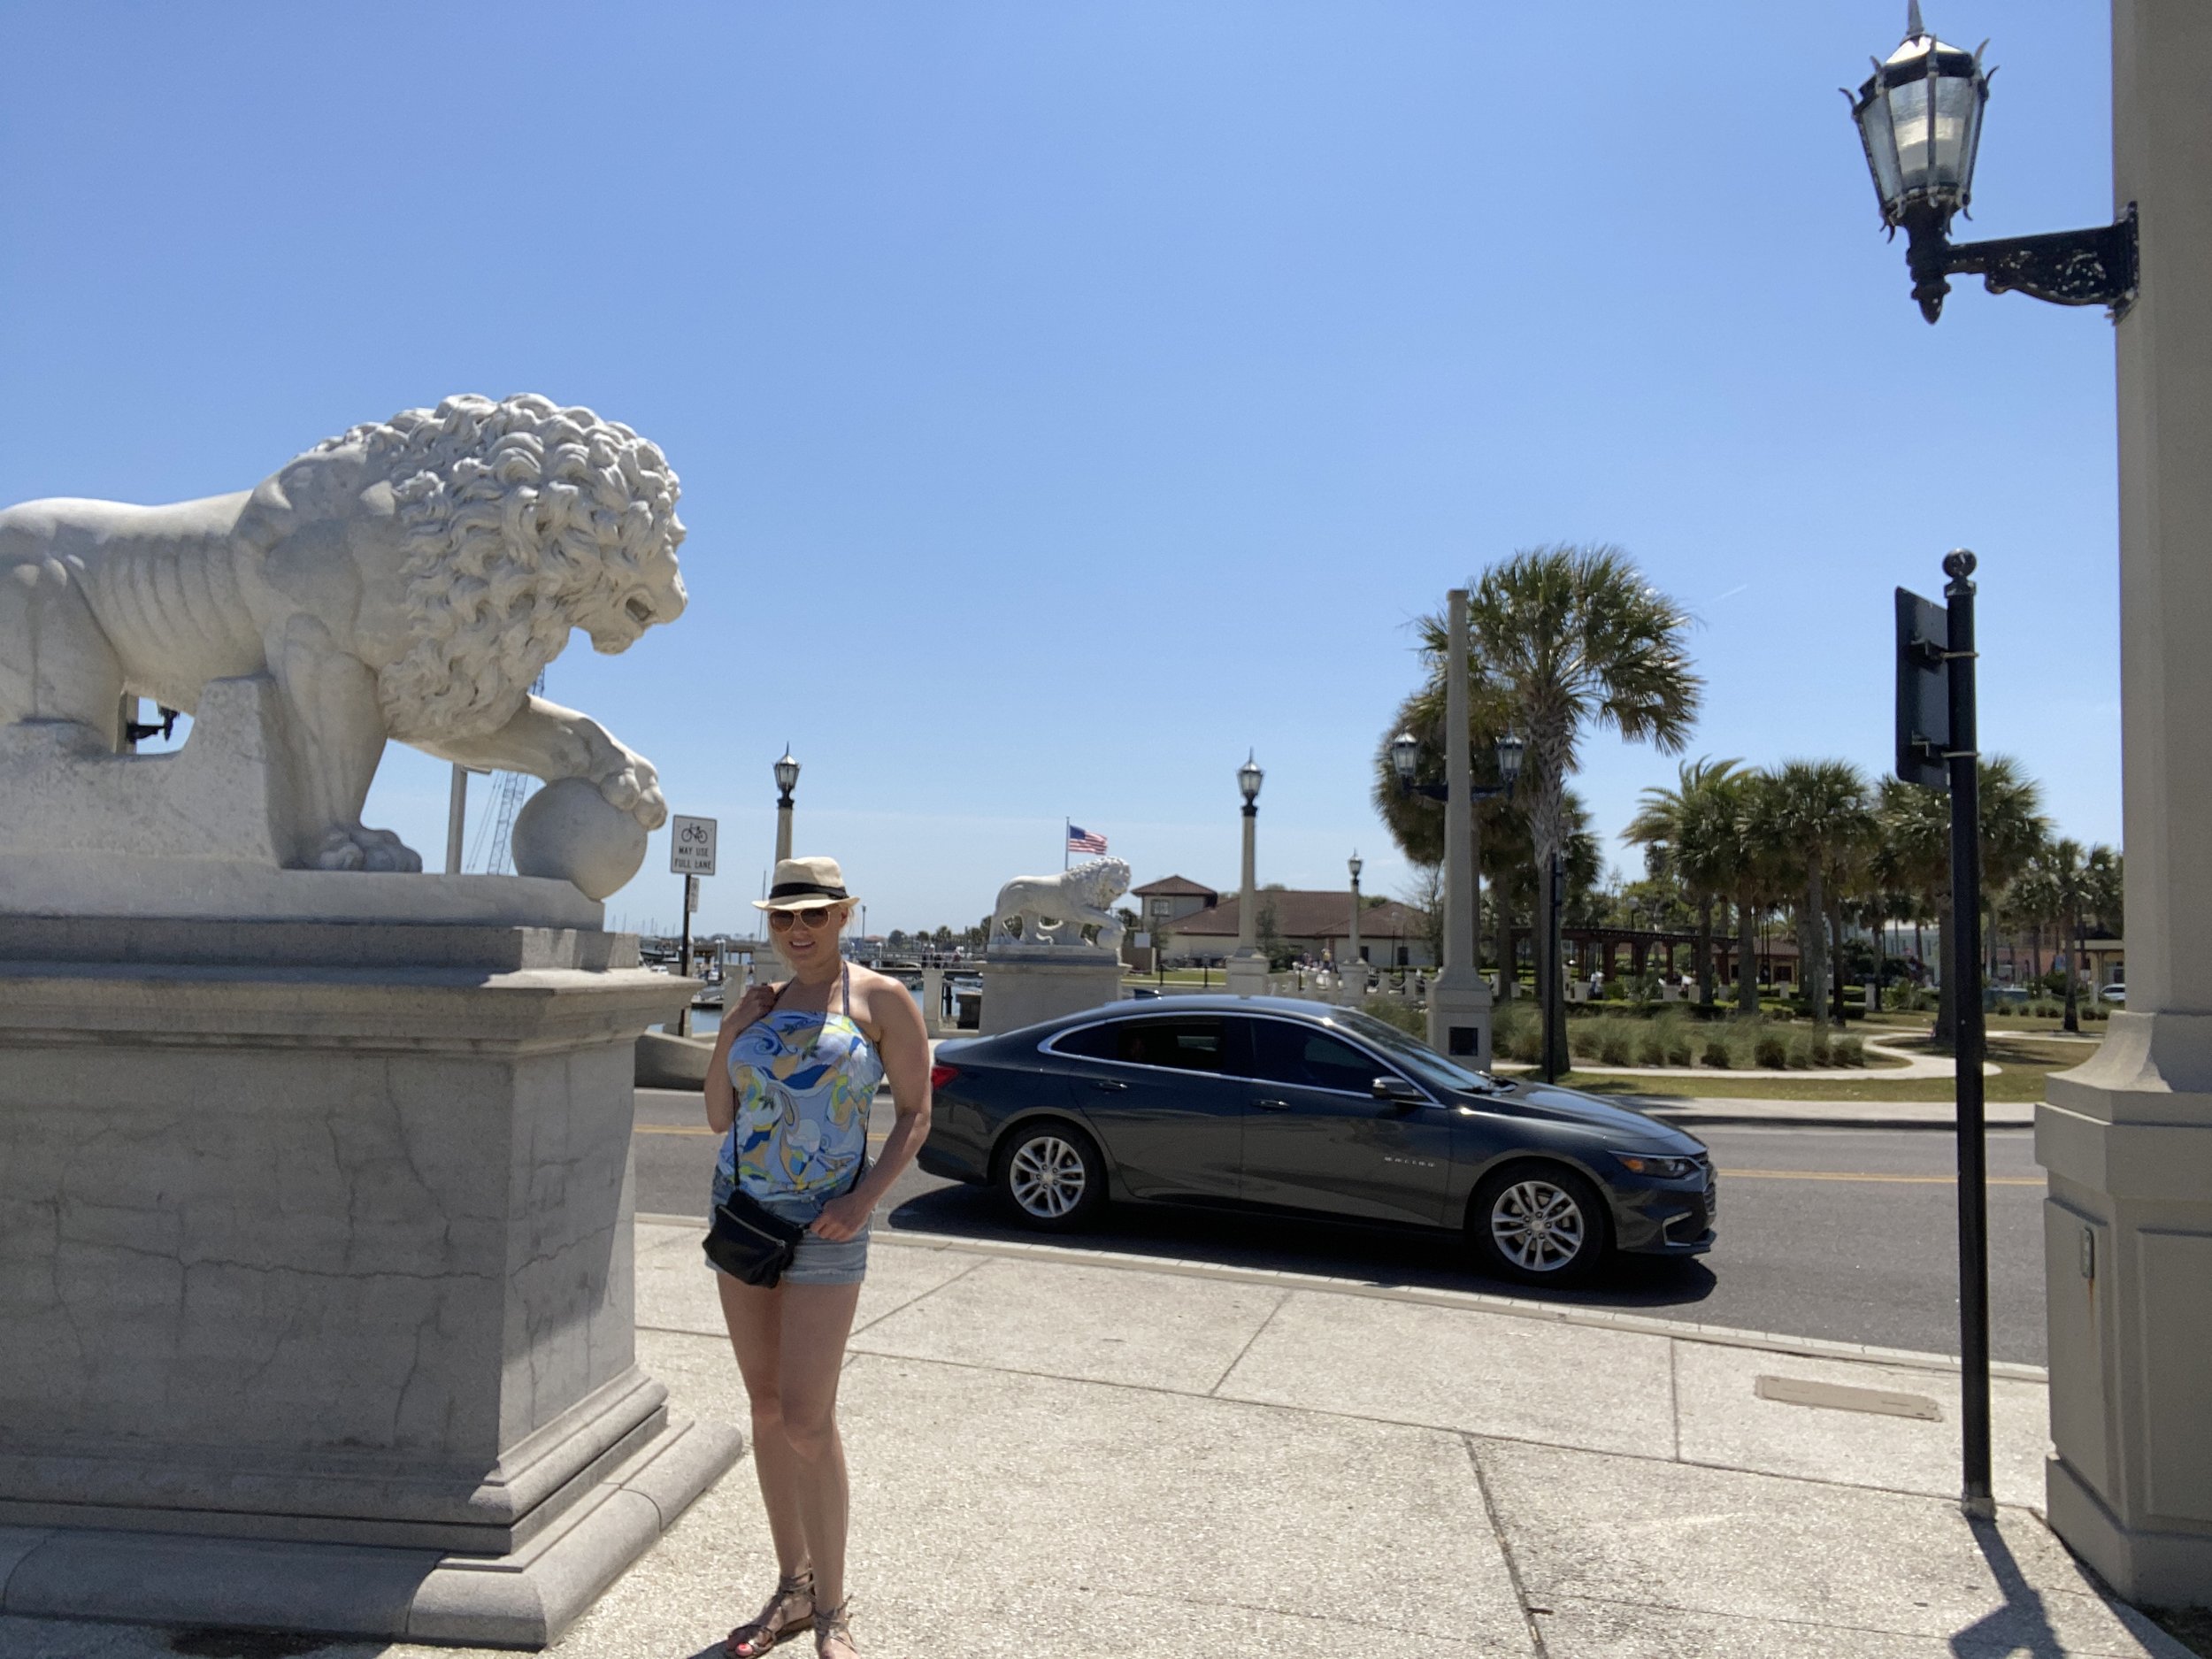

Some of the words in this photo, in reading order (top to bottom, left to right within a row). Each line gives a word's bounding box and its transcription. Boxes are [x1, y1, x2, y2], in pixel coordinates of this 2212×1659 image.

[679, 846, 693, 855] MAY
[695, 848, 708, 856] USE
[674, 858, 691, 868] FULL
[695, 860, 711, 870] LANE
